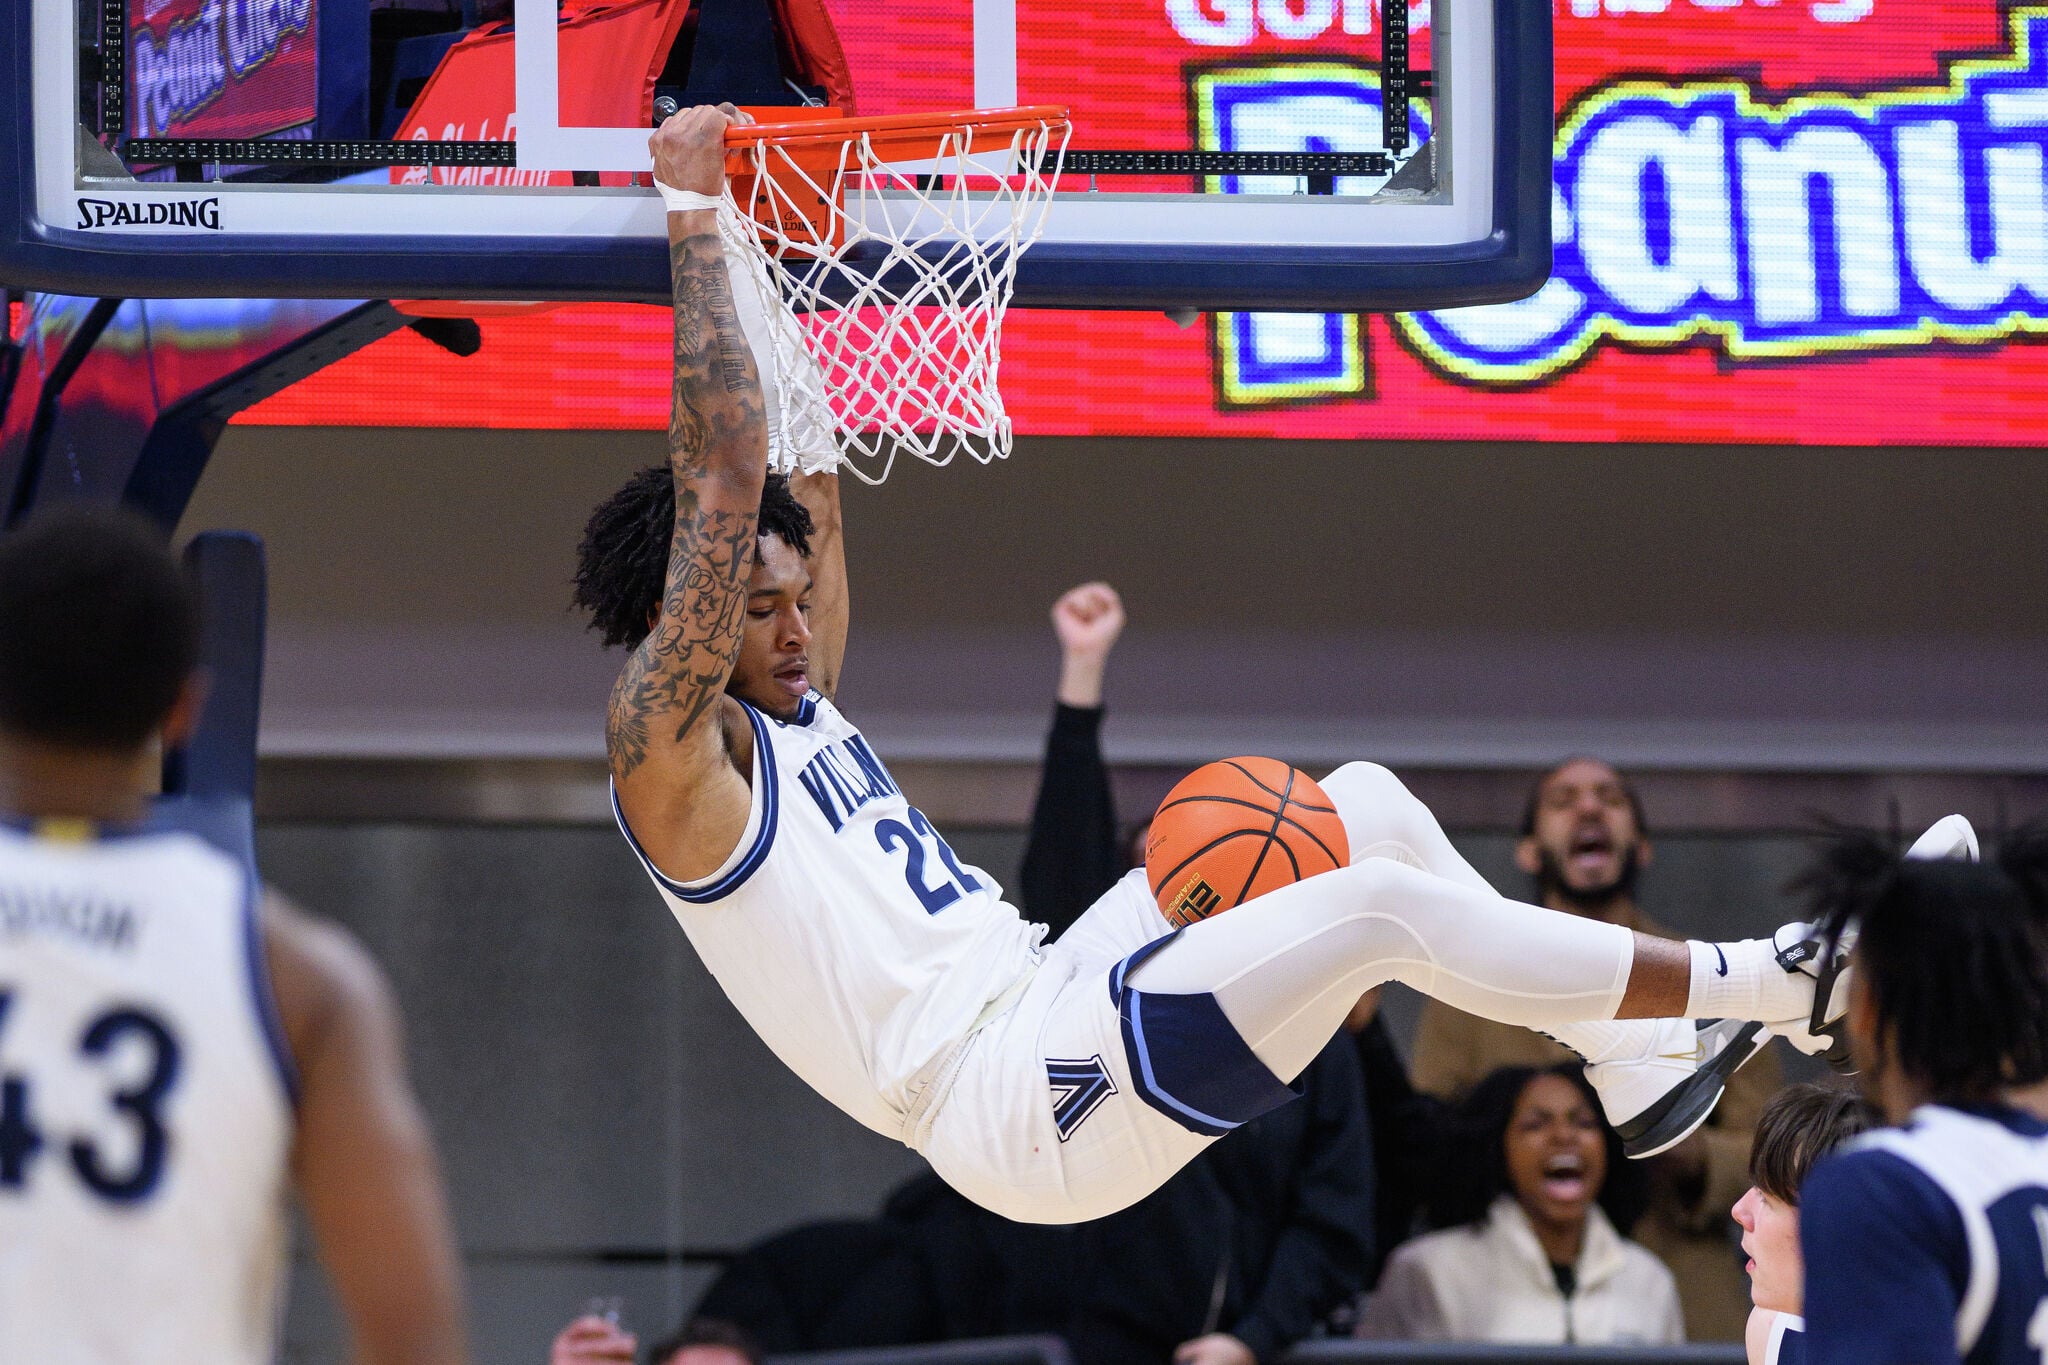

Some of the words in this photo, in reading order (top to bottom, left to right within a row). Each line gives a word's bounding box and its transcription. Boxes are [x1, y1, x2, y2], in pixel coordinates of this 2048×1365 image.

[77, 197, 219, 230] SPALDING
[701, 263, 751, 393] WHITMORE
[874, 805, 985, 917] 22
